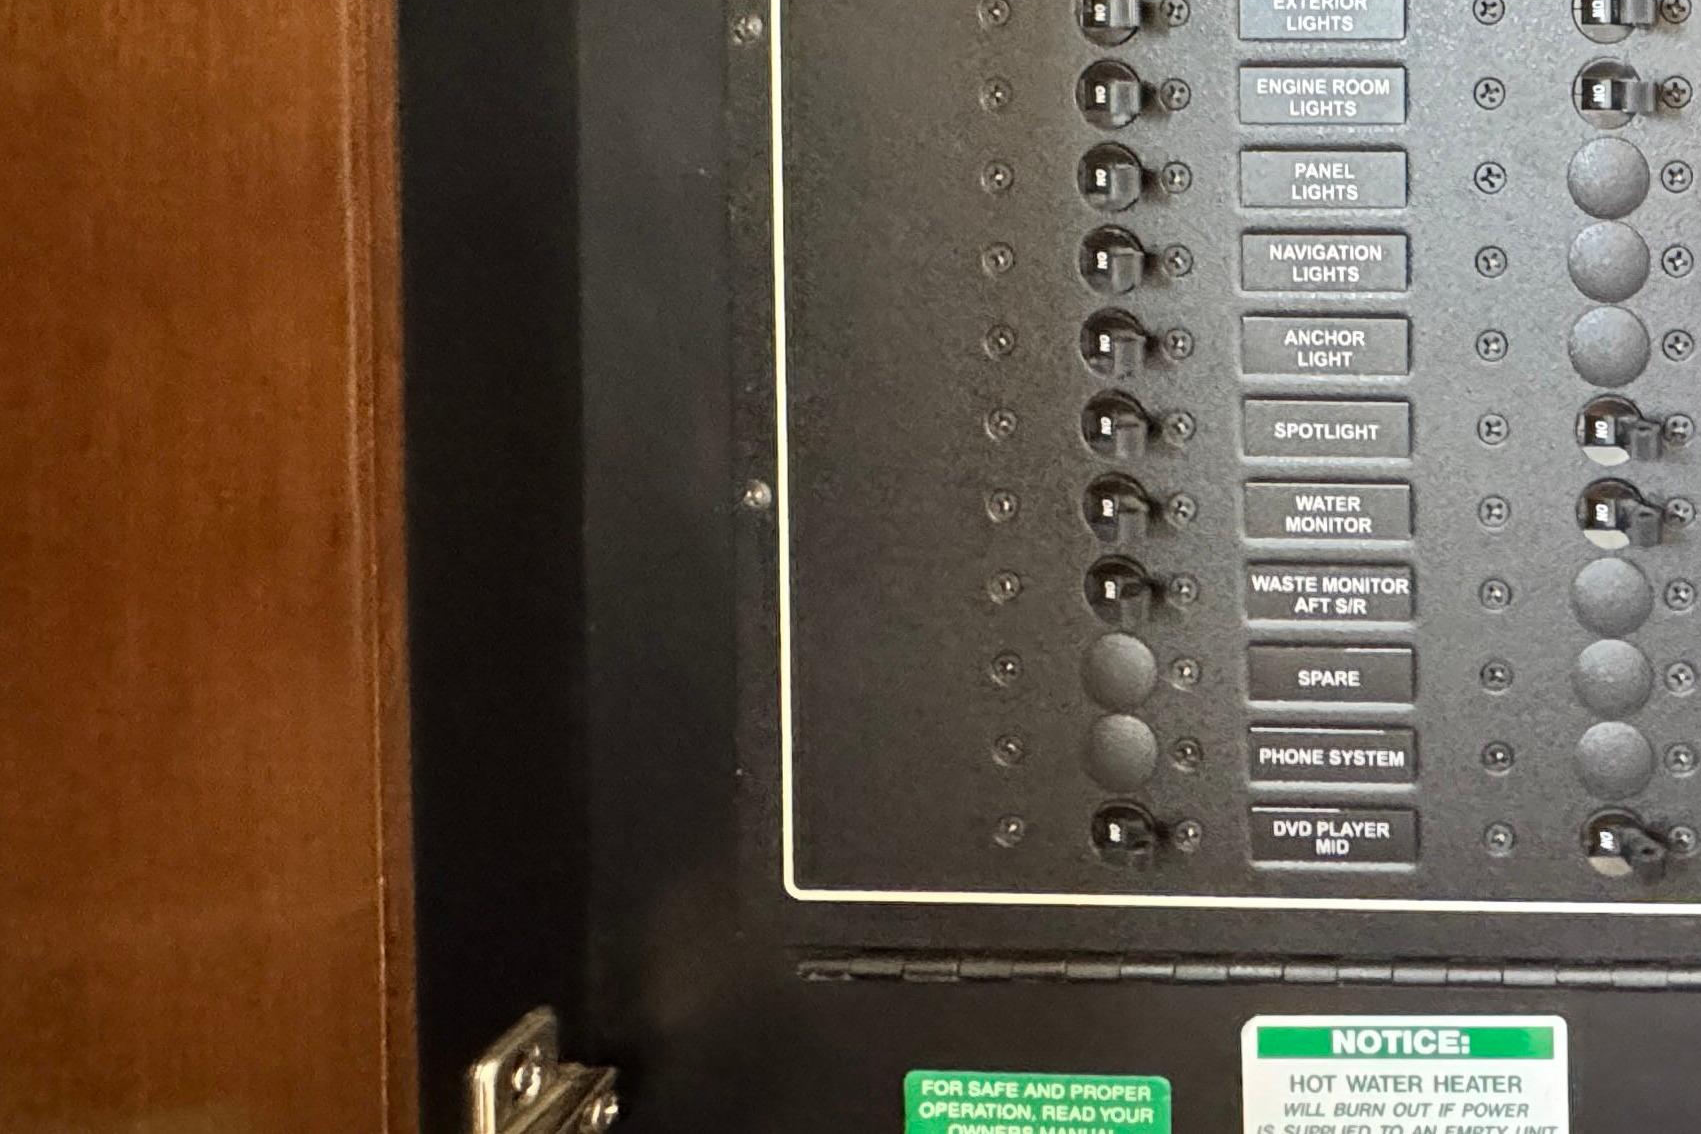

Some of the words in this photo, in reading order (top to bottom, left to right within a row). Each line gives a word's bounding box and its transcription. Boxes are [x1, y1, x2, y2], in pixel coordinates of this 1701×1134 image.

[1286, 16, 1354, 32] LIGHTS
[1256, 79, 1327, 95] ENGINE
[1332, 79, 1390, 95] ROOM
[1290, 101, 1356, 116] LIGHTS
[1295, 163, 1354, 179] PANEL
[1291, 184, 1358, 200] LIGHTS
[1269, 245, 1381, 261] NAVIGATION
[1292, 266, 1359, 282] LIGHTS
[1284, 330, 1365, 347] ANCHOR
[1298, 350, 1353, 367] LIGHT
[1274, 422, 1378, 440] SPOTLIGHT
[1295, 495, 1360, 512] WATER
[1285, 516, 1372, 532] MONITOR
[1251, 576, 1318, 594] WASTE
[1322, 576, 1410, 594] MONITOR
[1294, 598, 1332, 615] AFT
[1335, 598, 1367, 615] S/R
[1298, 670, 1360, 686] SPARE
[1259, 748, 1325, 767] PHONE
[1328, 748, 1405, 767] SYSTEM
[1273, 821, 1313, 838] DVD
[1316, 821, 1390, 838] PLAYER
[1316, 838, 1349, 855] MID
[1332, 1030, 1471, 1054] NOTICE:
[920, 1080, 963, 1096] FOR
[967, 1081, 1020, 1098] SAFE
[1024, 1083, 1066, 1100] AND
[1070, 1084, 1151, 1101] PROPER
[1289, 1074, 1338, 1094] HOT
[1345, 1074, 1423, 1094] WATER
[1433, 1074, 1523, 1094] HEATER
[918, 1102, 1037, 1122] OPERATION,
[1042, 1105, 1096, 1122] READ
[1099, 1107, 1154, 1123] YOUR
[1284, 1102, 1326, 1118] WILL
[1333, 1102, 1386, 1118] BURN
[1392, 1102, 1433, 1118] OUT
[1438, 1102, 1457, 1118] IF
[1461, 1102, 1530, 1118] POWER
